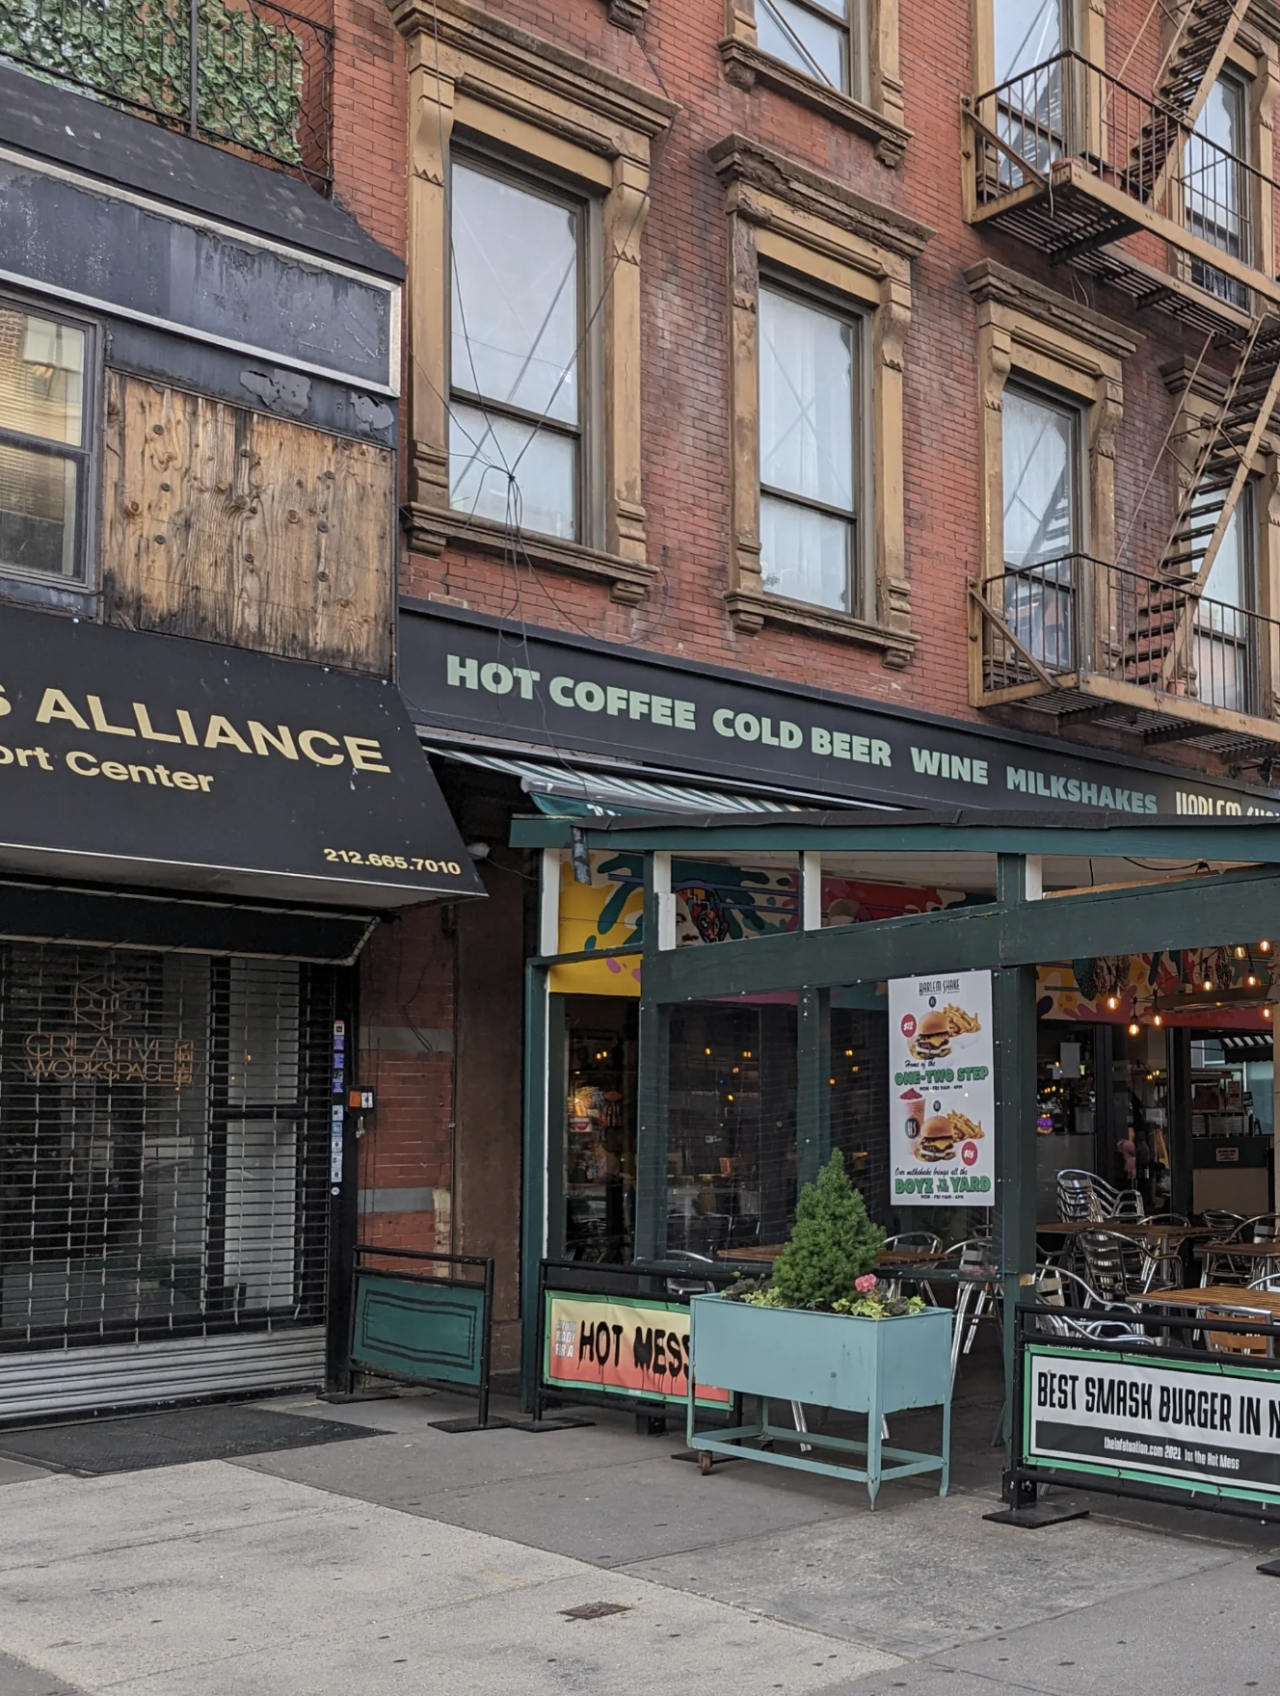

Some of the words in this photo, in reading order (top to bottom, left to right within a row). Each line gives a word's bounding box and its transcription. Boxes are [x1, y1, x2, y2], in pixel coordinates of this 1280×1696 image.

[35, 687, 392, 773] ALLIANCE
[445, 654, 540, 700] HOT
[549, 675, 697, 731] COFFEE
[712, 708, 803, 750] COLD
[810, 726, 893, 767] BEER
[909, 746, 989, 786] WINE
[1006, 766, 1158, 815] MILKSHAKES
[65, 750, 215, 793] Center
[323, 847, 462, 876] 212.665.7010
[919, 980, 942, 997] HARLEM
[943, 978, 960, 994] SHAKE
[27, 1058, 174, 1082] WORKSPACE
[894, 1068, 955, 1086] ONE-TWO
[957, 1065, 989, 1082] STEP
[904, 1059, 920, 1068] Home
[920, 1060, 927, 1069] of
[928, 1059, 936, 1067] the
[894, 1167, 905, 1176] Our
[906, 1167, 932, 1176] milkshake
[959, 1167, 968, 1176] the
[895, 1177, 934, 1195] BOYZ
[950, 1175, 992, 1193] YARD
[577, 1320, 624, 1370] HOT
[1037, 1371, 1080, 1410] BEST
[1084, 1376, 1153, 1420] SMASH
[1158, 1385, 1232, 1433] BURGER
[1239, 1395, 1261, 1436] IN
[1103, 1435, 1164, 1458] theinfatuation.com
[1164, 1445, 1182, 1461] 2021
[1194, 1448, 1206, 1465] the
[1207, 1451, 1219, 1468] Hot
[1219, 1453, 1240, 1471] Mess
